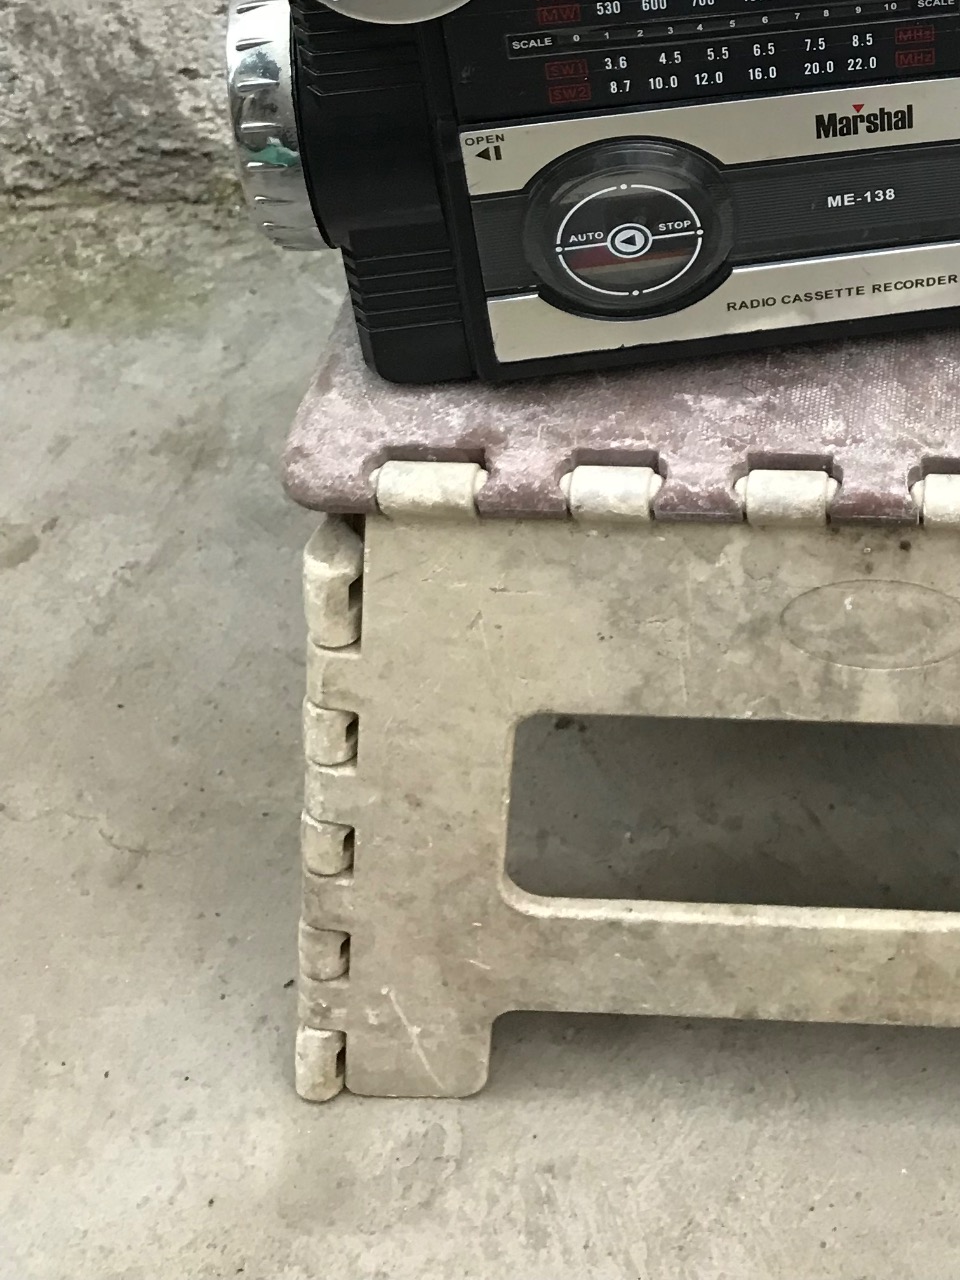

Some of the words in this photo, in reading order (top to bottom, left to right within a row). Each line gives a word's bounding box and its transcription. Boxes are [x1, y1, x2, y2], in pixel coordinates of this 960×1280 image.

[512, 37, 553, 50] SCALE
[573, 34, 580, 42] 0
[636, 29, 644, 37] 2
[667, 27, 674, 35] 3
[696, 23, 703, 32] 4
[729, 20, 736, 28] 5
[761, 16, 769, 24] 6
[794, 12, 800, 20] 7
[823, 9, 829, 17] 8
[855, 6, 862, 14] 9
[884, 2, 897, 10] 10
[541, 8, 576, 22] MW
[596, 0, 621, 15] 530
[551, 63, 586, 76] SW1
[604, 56, 628, 70] 3.6
[659, 51, 682, 65] 4.5
[707, 46, 729, 60] 5.5
[753, 42, 775, 57] 6.5
[805, 37, 826, 52] 7.5
[852, 33, 873, 47] 8.5
[554, 87, 588, 101] SW2
[610, 80, 631, 94] 8.7
[648, 76, 678, 90] 10.0
[694, 71, 723, 86] 12.0
[748, 66, 777, 81] 16.0
[804, 61, 834, 75] 20.0
[847, 56, 877, 71] 22.0
[900, 52, 932, 65] MHz
[815, 104, 913, 139] Marshal
[464, 133, 505, 146] OPEN
[827, 188, 896, 208] ME-138
[569, 231, 604, 243] AUTO
[658, 219, 692, 231] STOP
[727, 296, 776, 311] RADIO
[781, 286, 865, 305] CASSETTE
[872, 274, 958, 293] RECORDER
